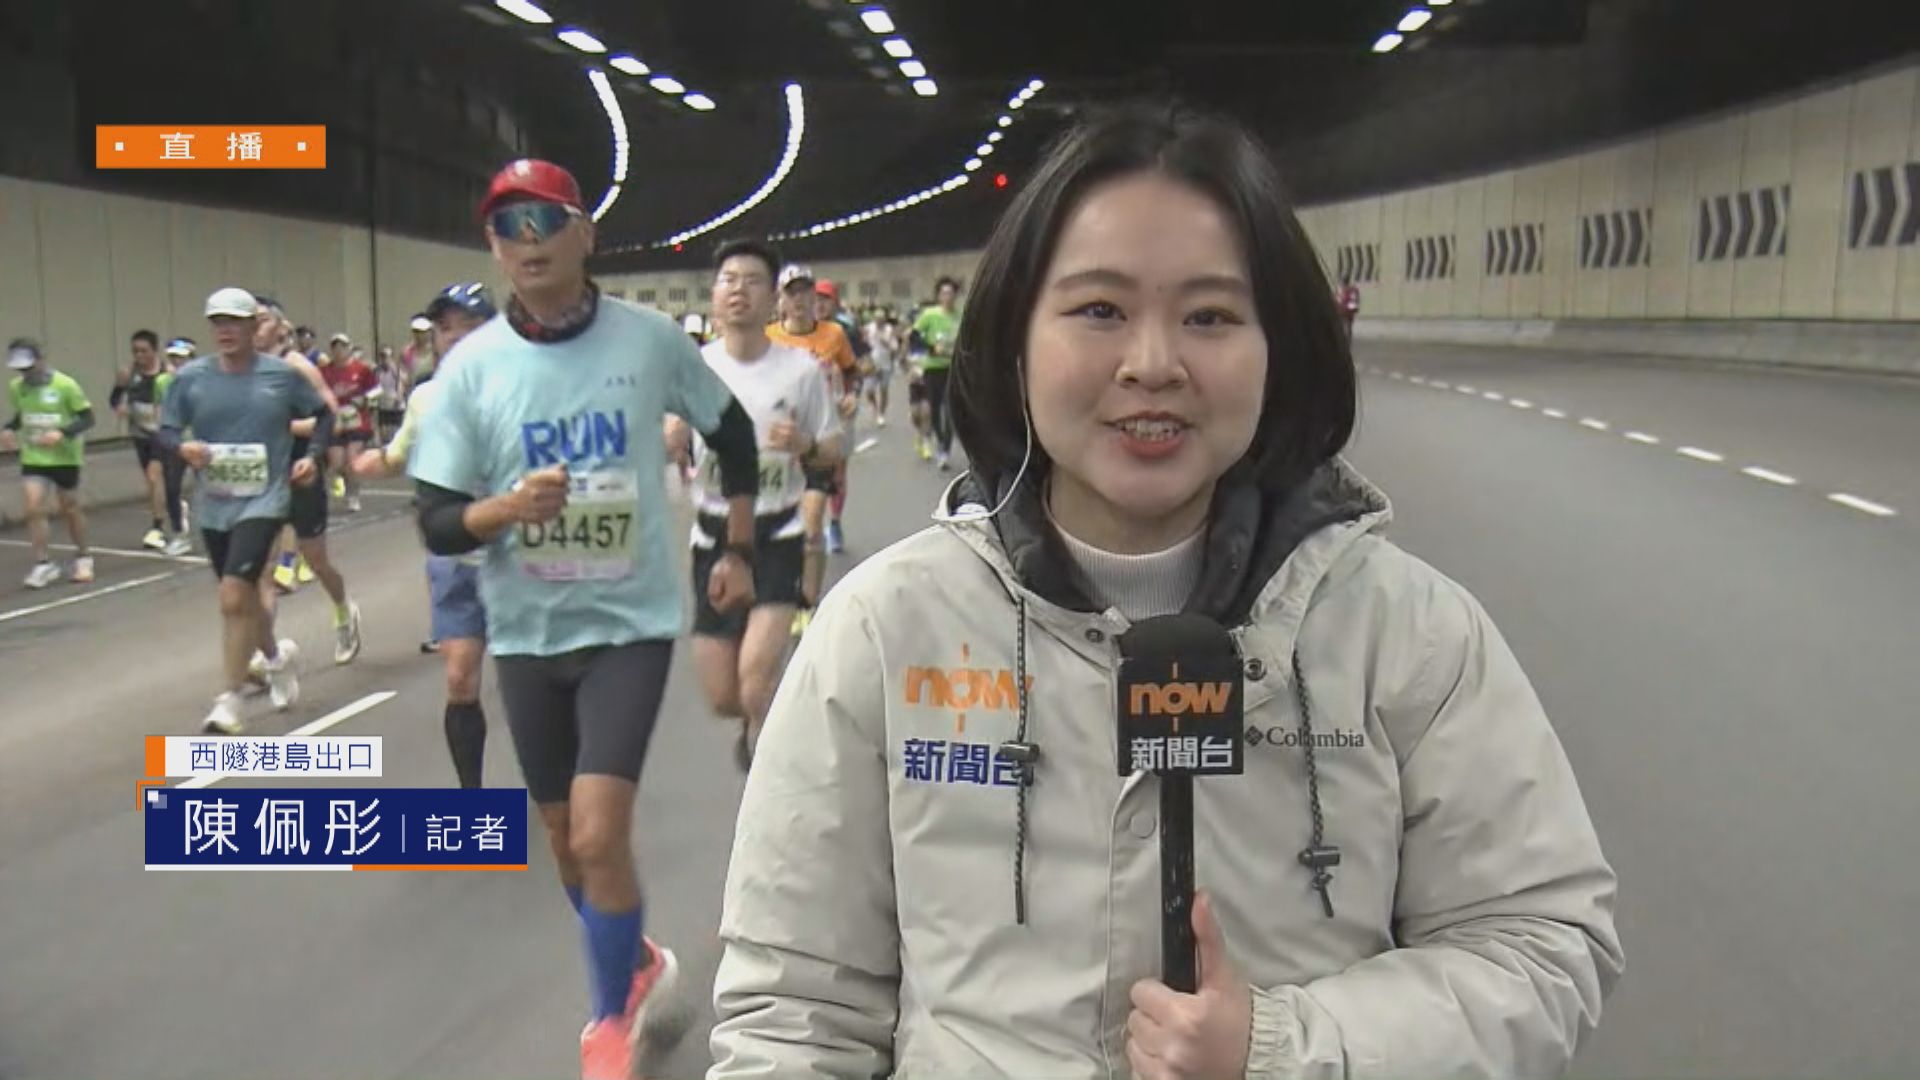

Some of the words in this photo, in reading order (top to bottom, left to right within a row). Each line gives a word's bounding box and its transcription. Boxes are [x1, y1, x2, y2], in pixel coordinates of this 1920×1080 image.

[522, 409, 627, 467] RUN
[906, 666, 1034, 710] now
[1131, 682, 1232, 715] now
[1131, 735, 1233, 770] 新聞台
